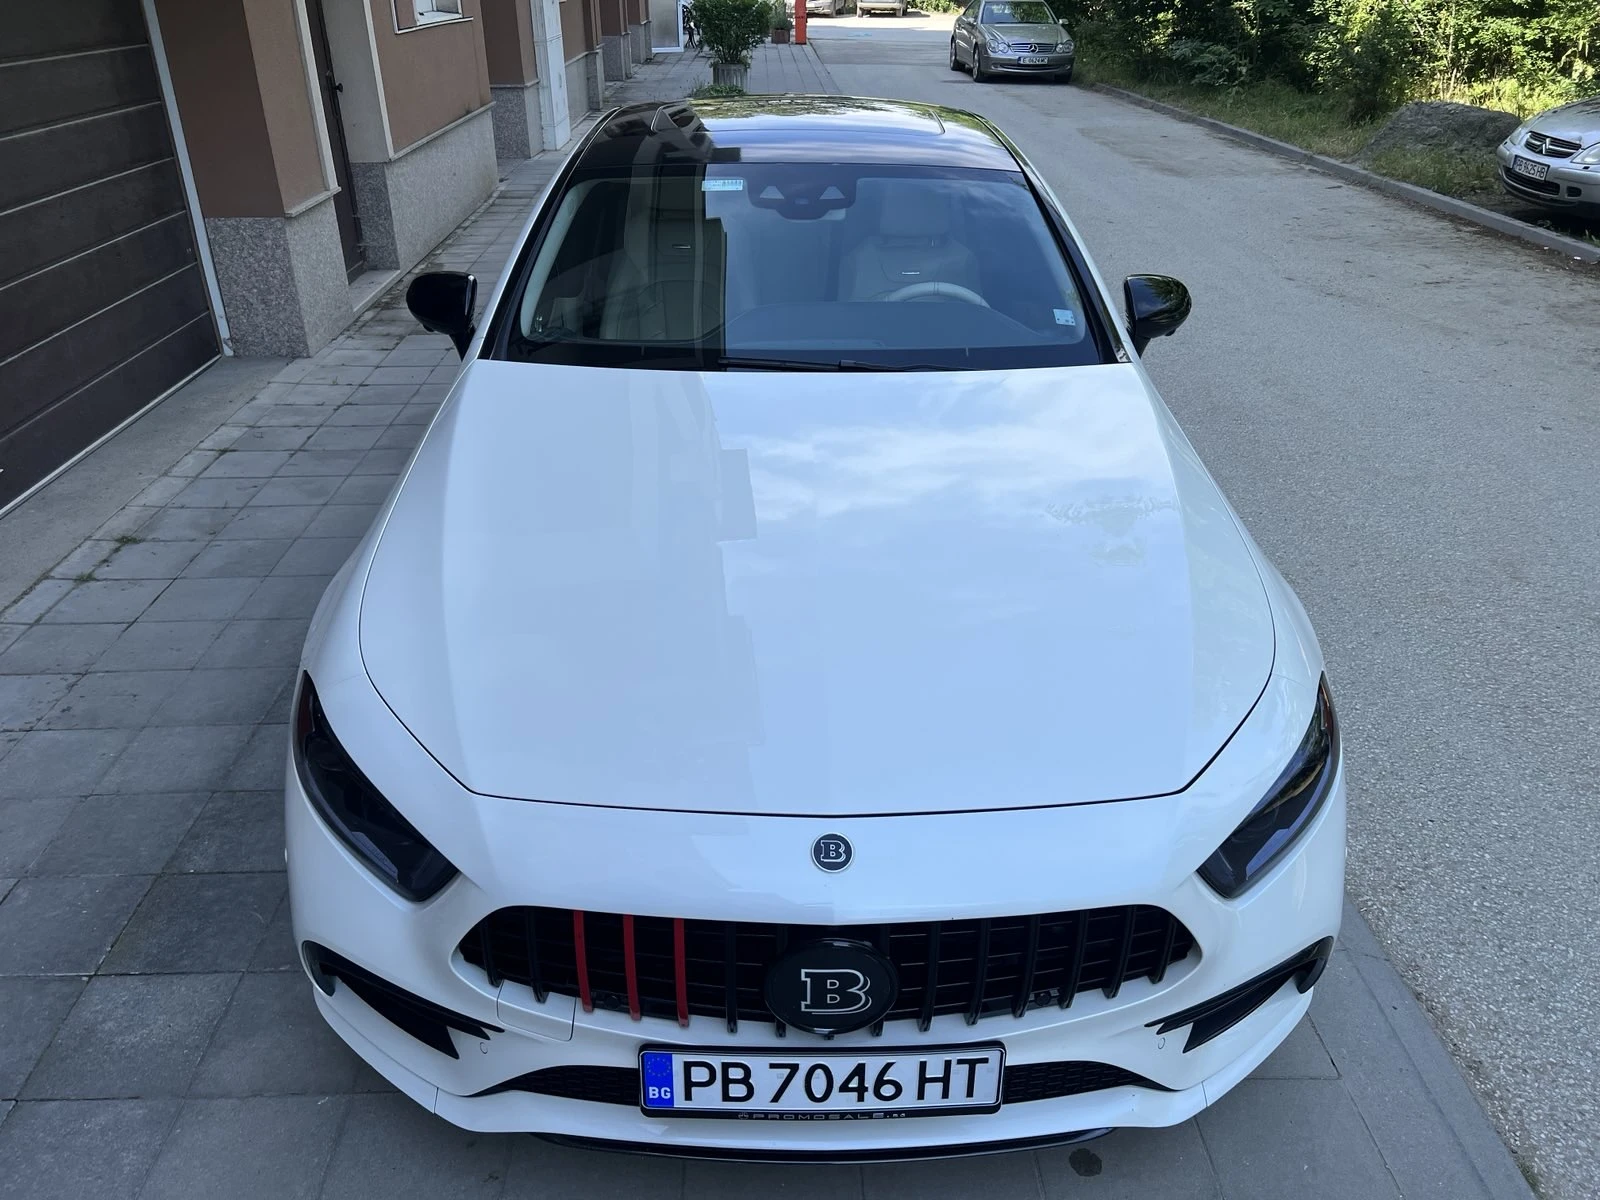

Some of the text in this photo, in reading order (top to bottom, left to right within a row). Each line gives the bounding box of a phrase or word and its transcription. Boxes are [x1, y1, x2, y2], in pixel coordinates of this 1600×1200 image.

[820, 840, 846, 862] B
[801, 968, 872, 1015] B
[648, 1086, 672, 1099] BG
[683, 1057, 990, 1104] PB 7046 HT
